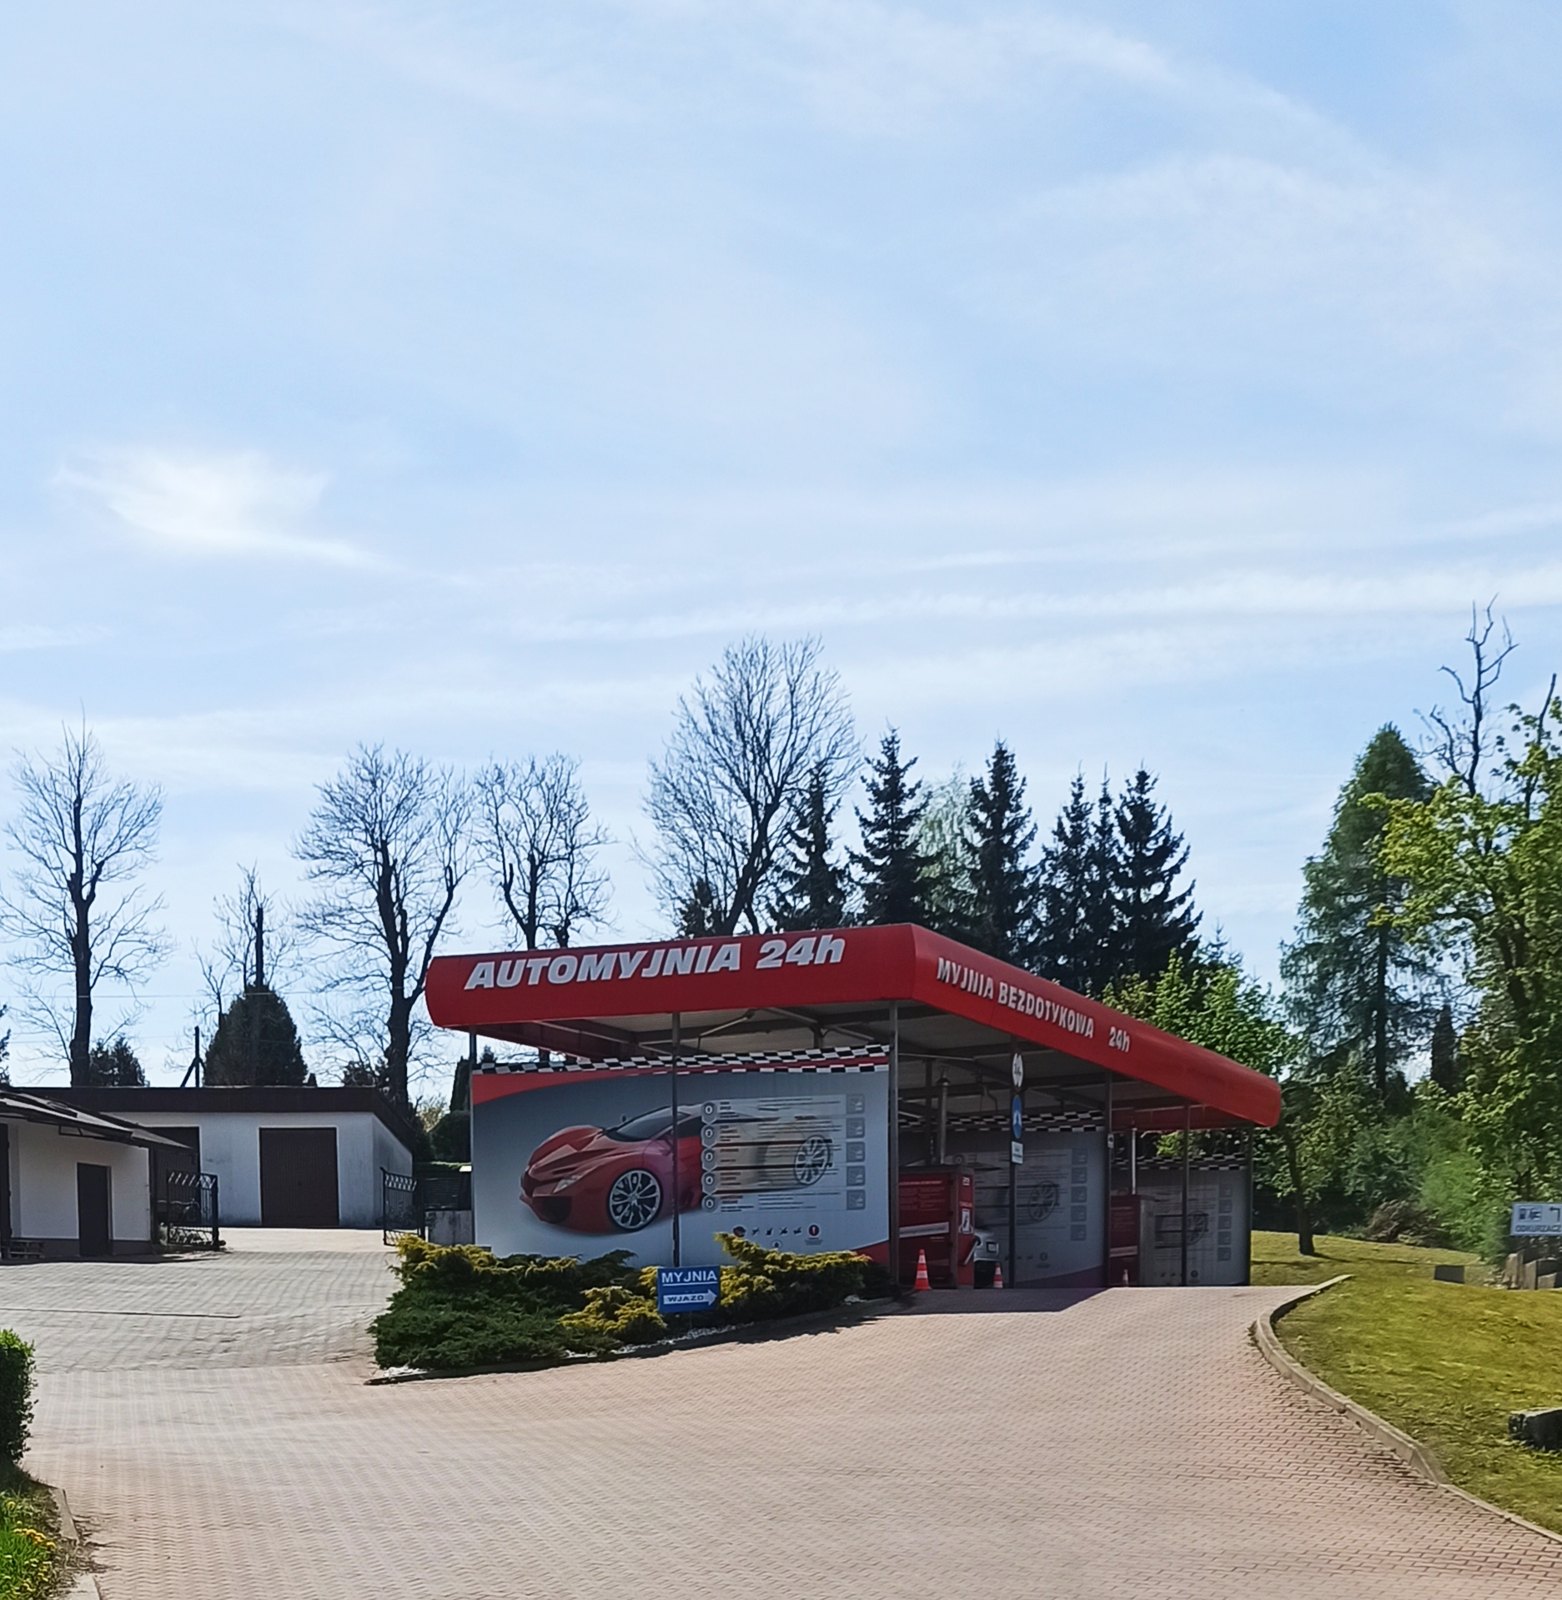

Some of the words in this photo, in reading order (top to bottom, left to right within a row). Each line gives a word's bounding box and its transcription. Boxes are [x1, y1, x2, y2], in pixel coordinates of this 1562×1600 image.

[464, 943, 741, 990] AUTOMYJNIA
[755, 934, 845, 970] 24h
[936, 957, 994, 999] MYJNIA
[998, 982, 1094, 1038] BEZDOTYKOWA
[1108, 1026, 1130, 1052] 24h
[661, 1270, 717, 1283] MYJNIA
